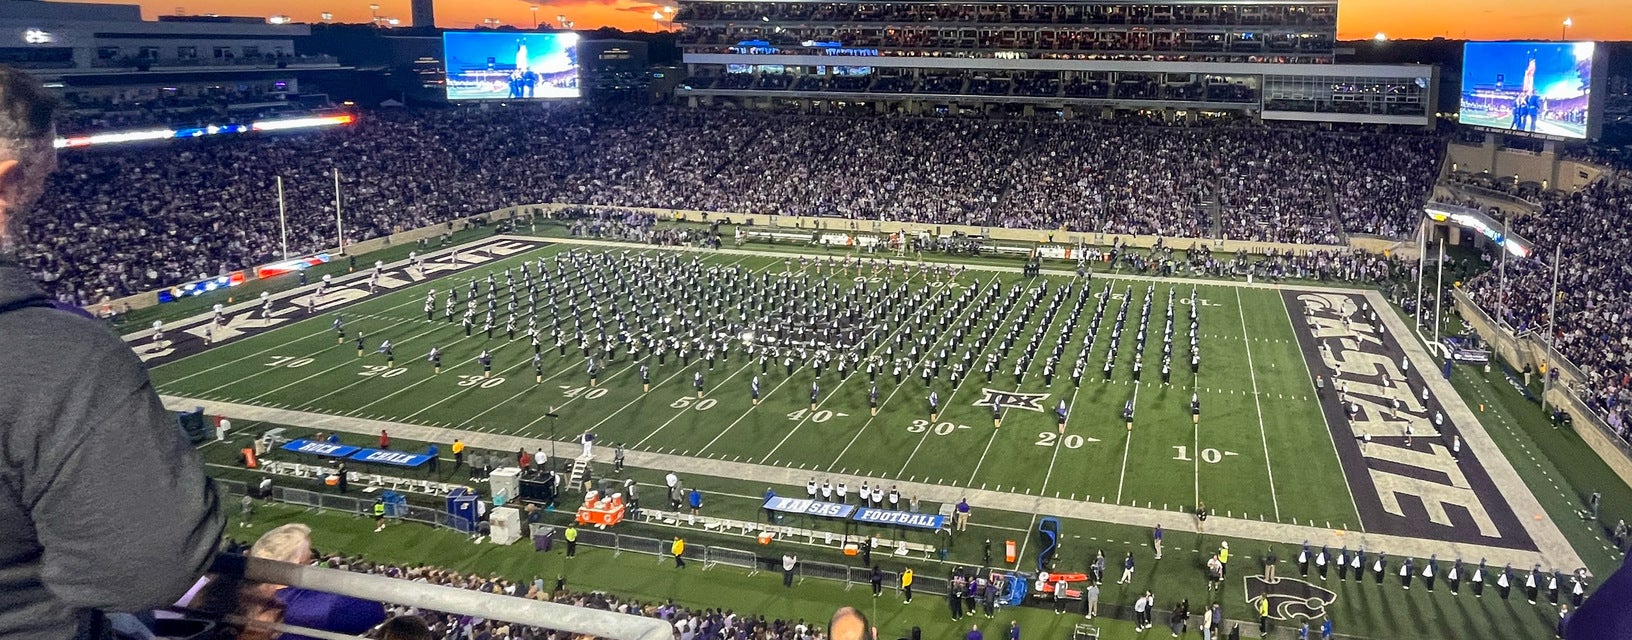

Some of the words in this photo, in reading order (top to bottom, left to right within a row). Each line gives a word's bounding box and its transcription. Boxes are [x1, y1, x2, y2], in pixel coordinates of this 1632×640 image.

[264, 355, 315, 368] 10
[357, 365, 408, 378] 20
[457, 375, 506, 389] 30
[562, 386, 609, 400] 40
[669, 396, 718, 411] 50
[786, 408, 833, 423] 40
[907, 419, 955, 436] 30
[1306, 315, 1502, 538] K-STATE
[1034, 431, 1084, 449] 20
[298, 442, 342, 455] ROCK
[366, 450, 417, 464] CHALK
[1172, 445, 1222, 463] 10
[776, 497, 842, 516] KANSAS
[861, 510, 936, 528] FOOTBALL
